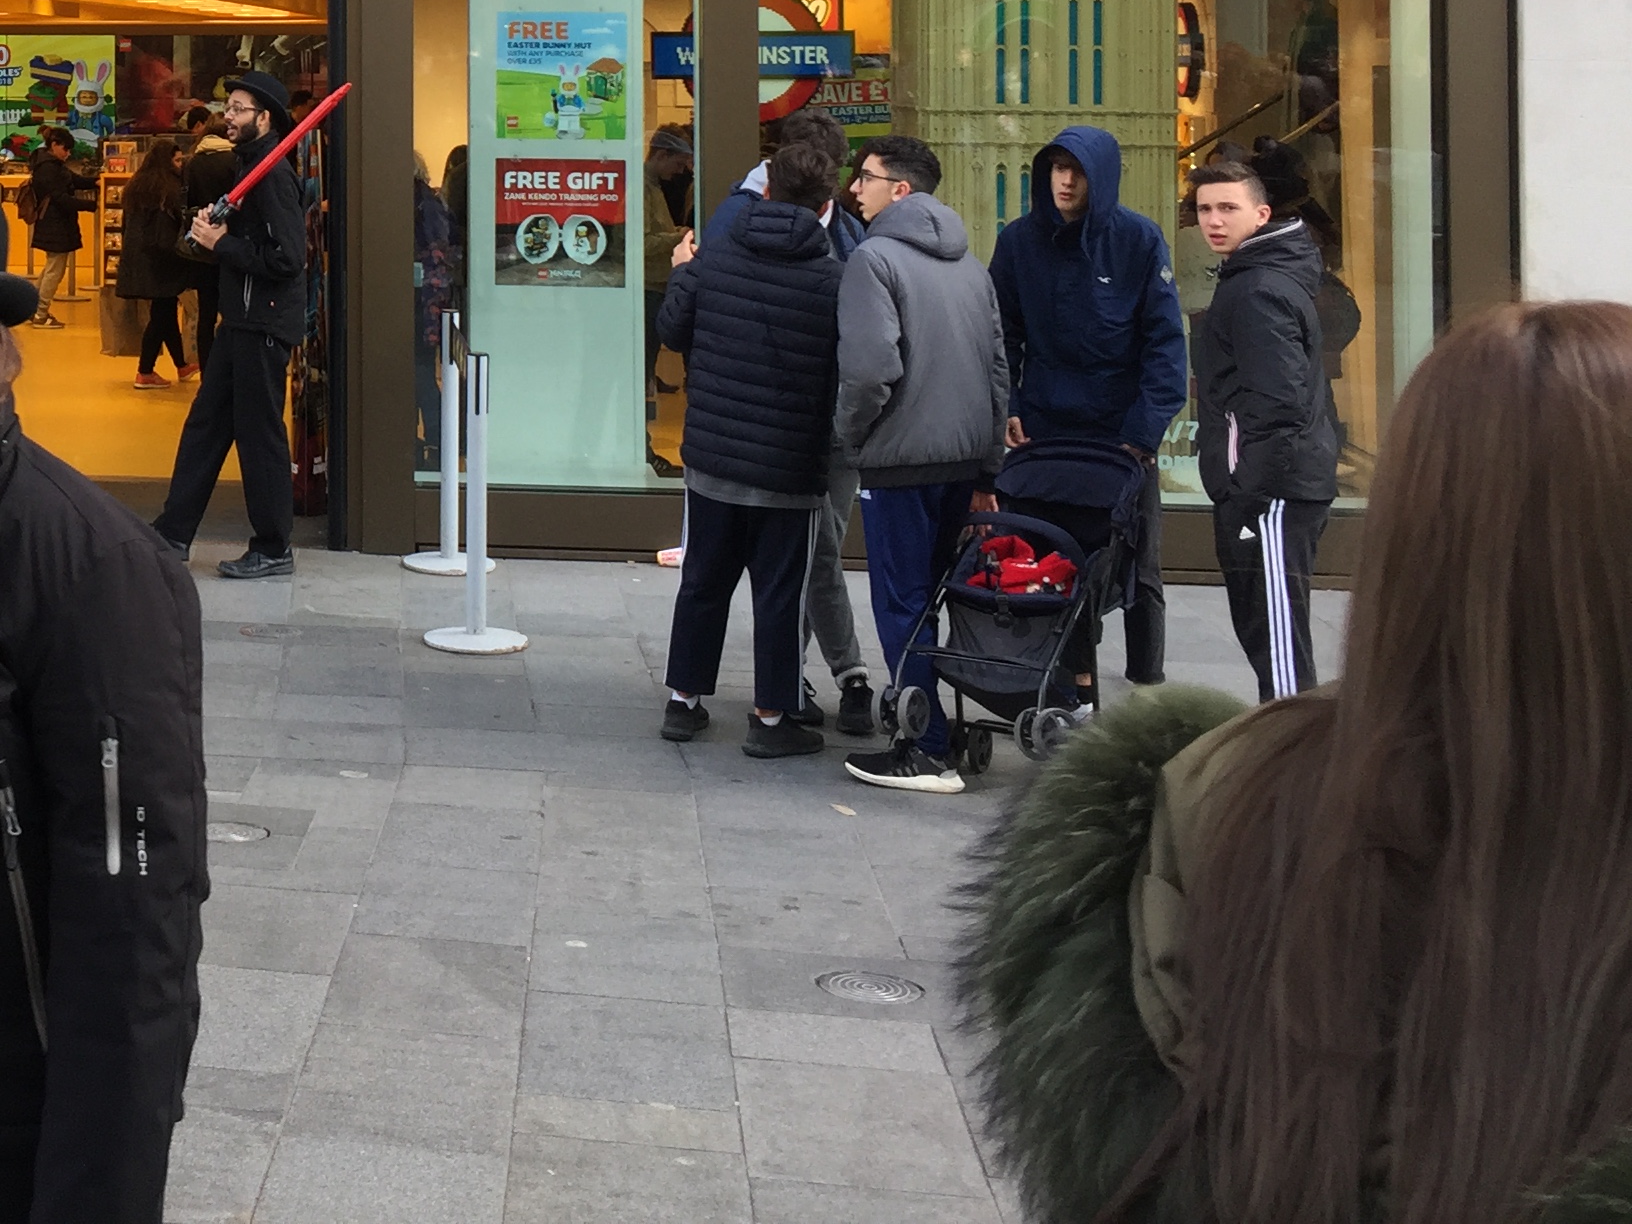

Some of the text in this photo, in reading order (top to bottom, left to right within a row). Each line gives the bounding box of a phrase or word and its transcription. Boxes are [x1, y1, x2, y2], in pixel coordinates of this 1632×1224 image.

[508, 21, 570, 40] FREE
[507, 41, 541, 49] EASTER
[504, 171, 619, 190] FREE GIFT
[504, 192, 527, 201] ZANE
[559, 192, 599, 201] TRAINING
[600, 193, 619, 202] POD
